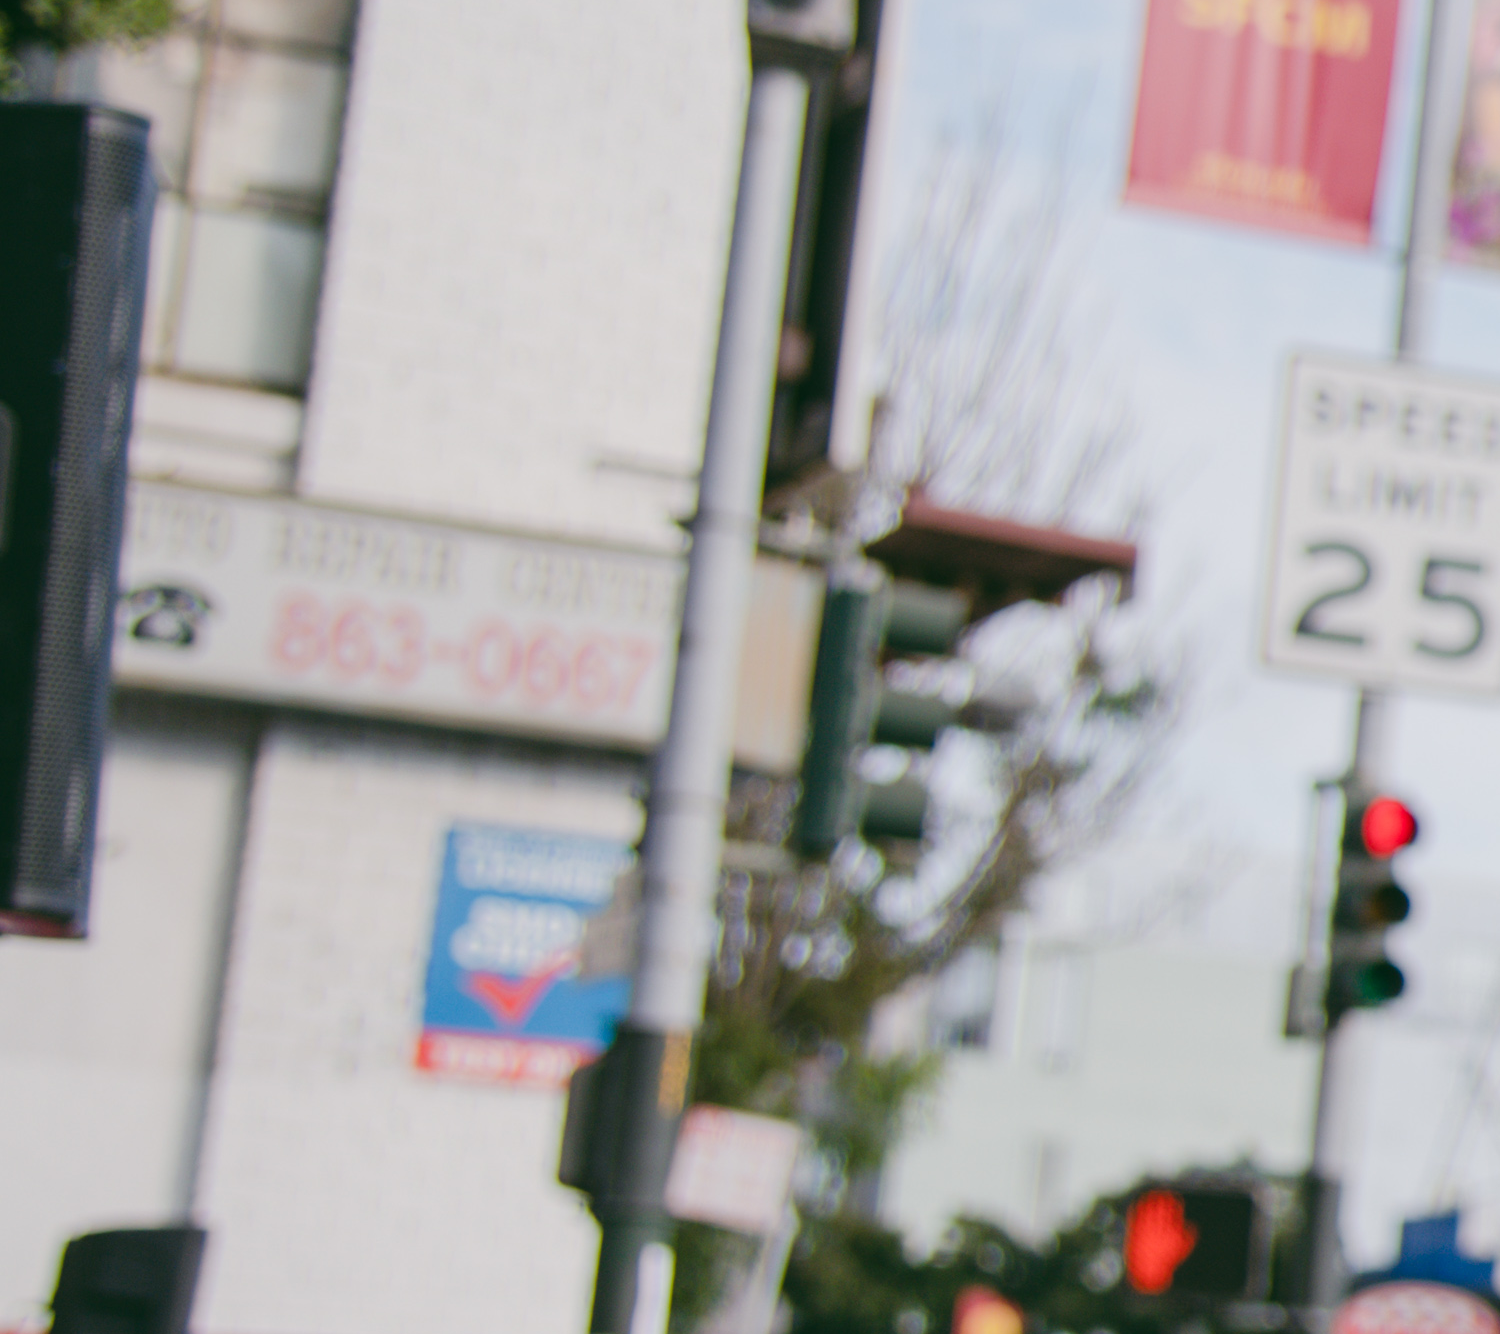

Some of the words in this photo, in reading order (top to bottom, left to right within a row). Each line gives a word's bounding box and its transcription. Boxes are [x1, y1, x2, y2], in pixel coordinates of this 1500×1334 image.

[1318, 463, 1490, 523] LIMIT
[270, 587, 664, 713] 863-0667
[1292, 540, 1488, 661] 25
